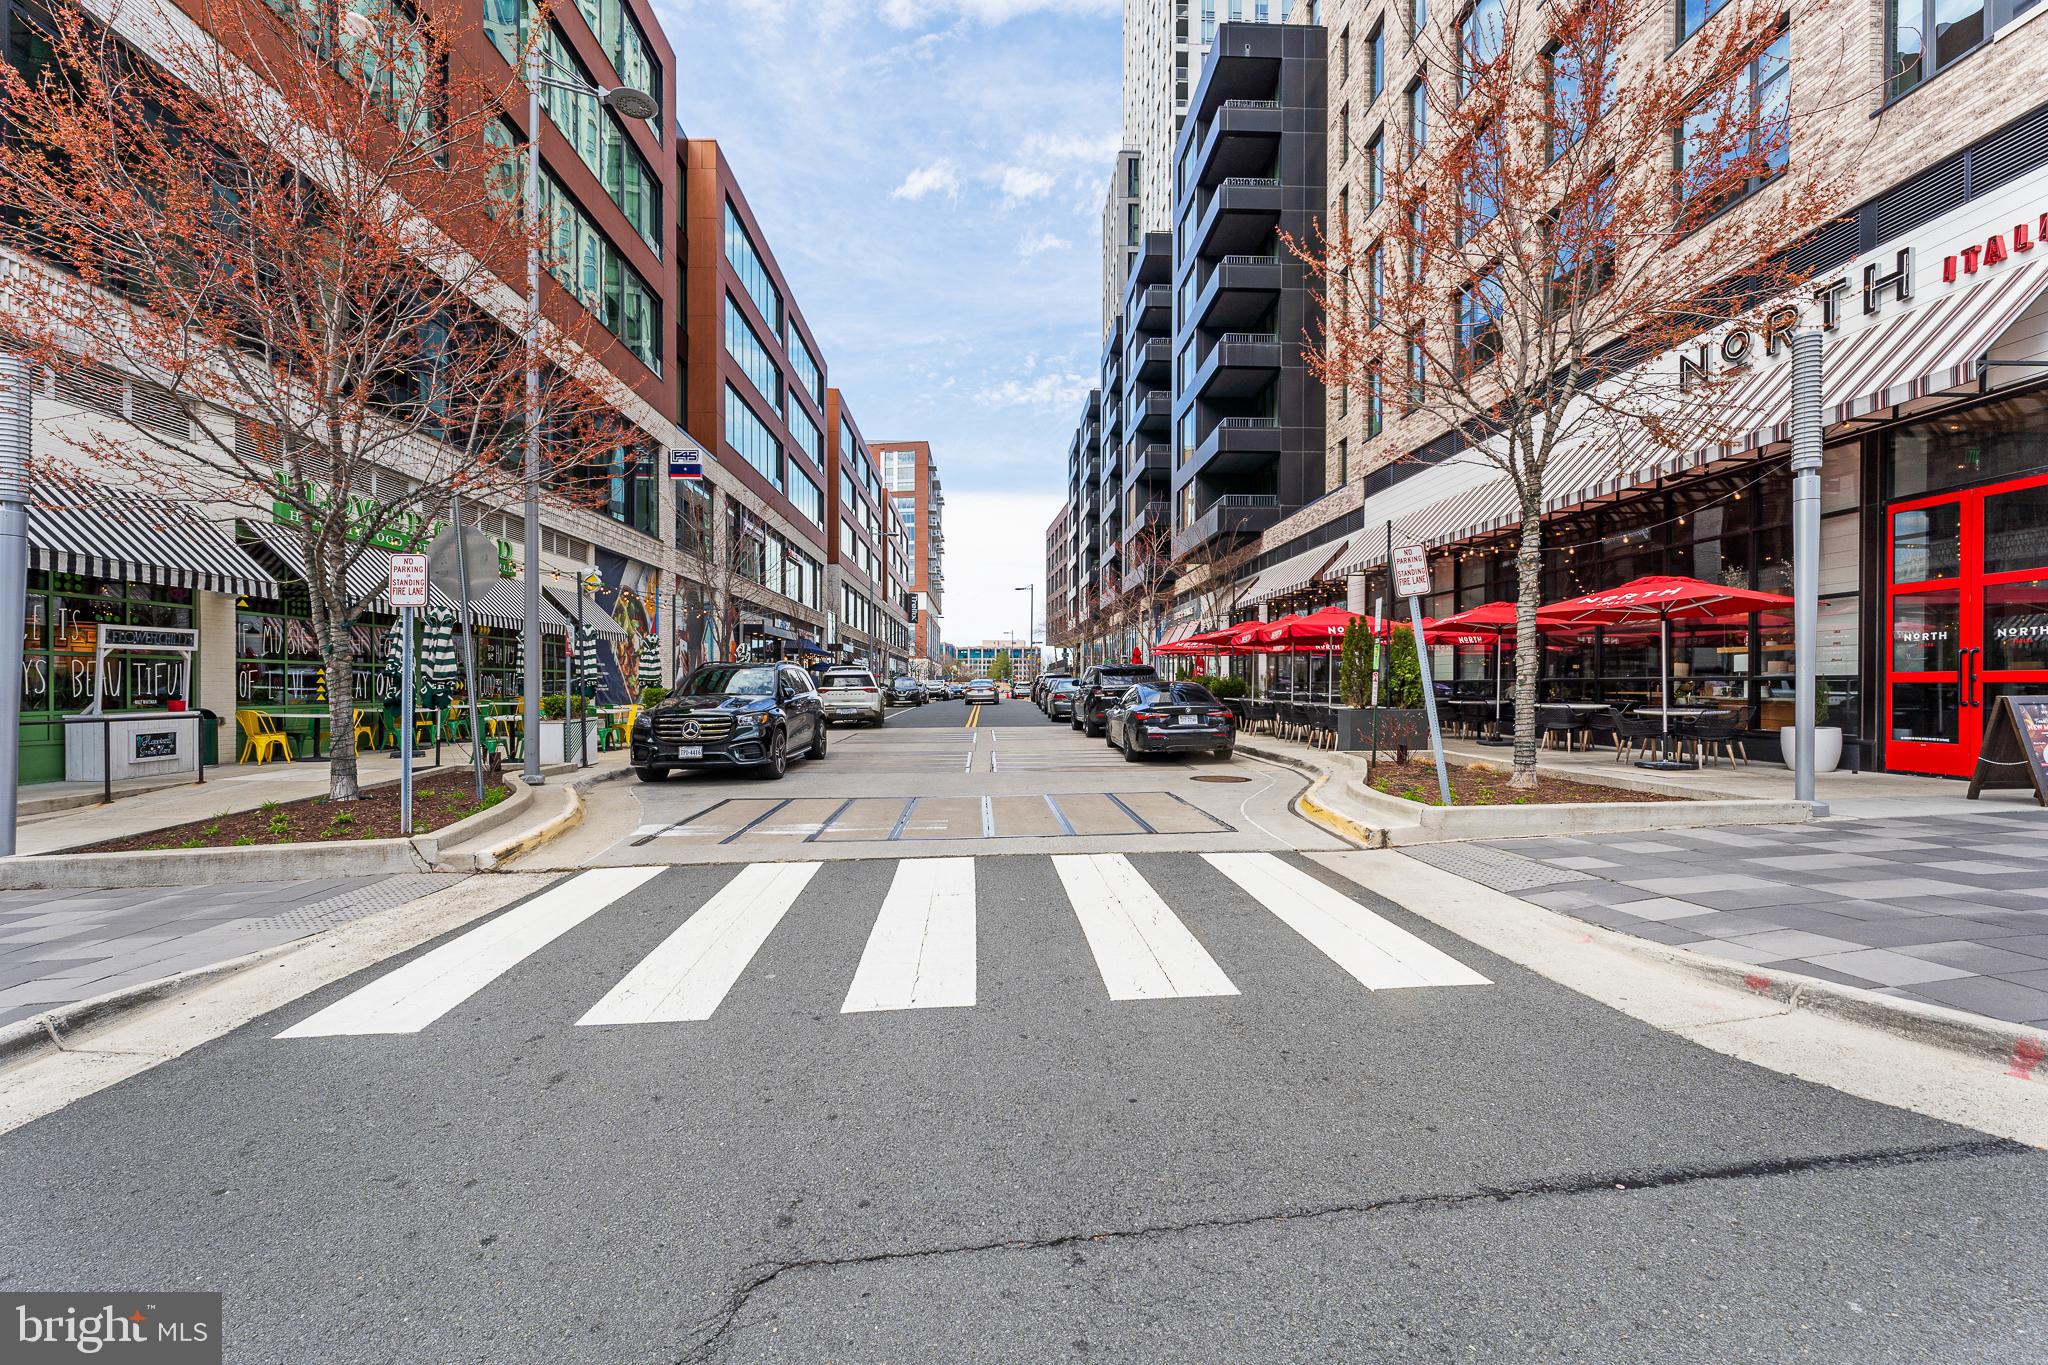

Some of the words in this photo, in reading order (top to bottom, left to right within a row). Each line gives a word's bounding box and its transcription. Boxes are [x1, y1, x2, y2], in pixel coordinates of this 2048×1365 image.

[1680, 247, 1915, 393] NORTH
[673, 450, 699, 462] F45
[1396, 556, 1423, 564] PARKING
[1397, 568, 1426, 577] STANDING
[1399, 577, 1411, 586] FIRE
[1412, 575, 1427, 585] LANE
[392, 587, 406, 595] FIRE
[408, 587, 424, 595] LANE
[58, 607, 81, 641] IS
[1903, 631, 1948, 642] NORTH
[1997, 625, 2048, 638] NORTH
[1458, 636, 1482, 644] NORTH
